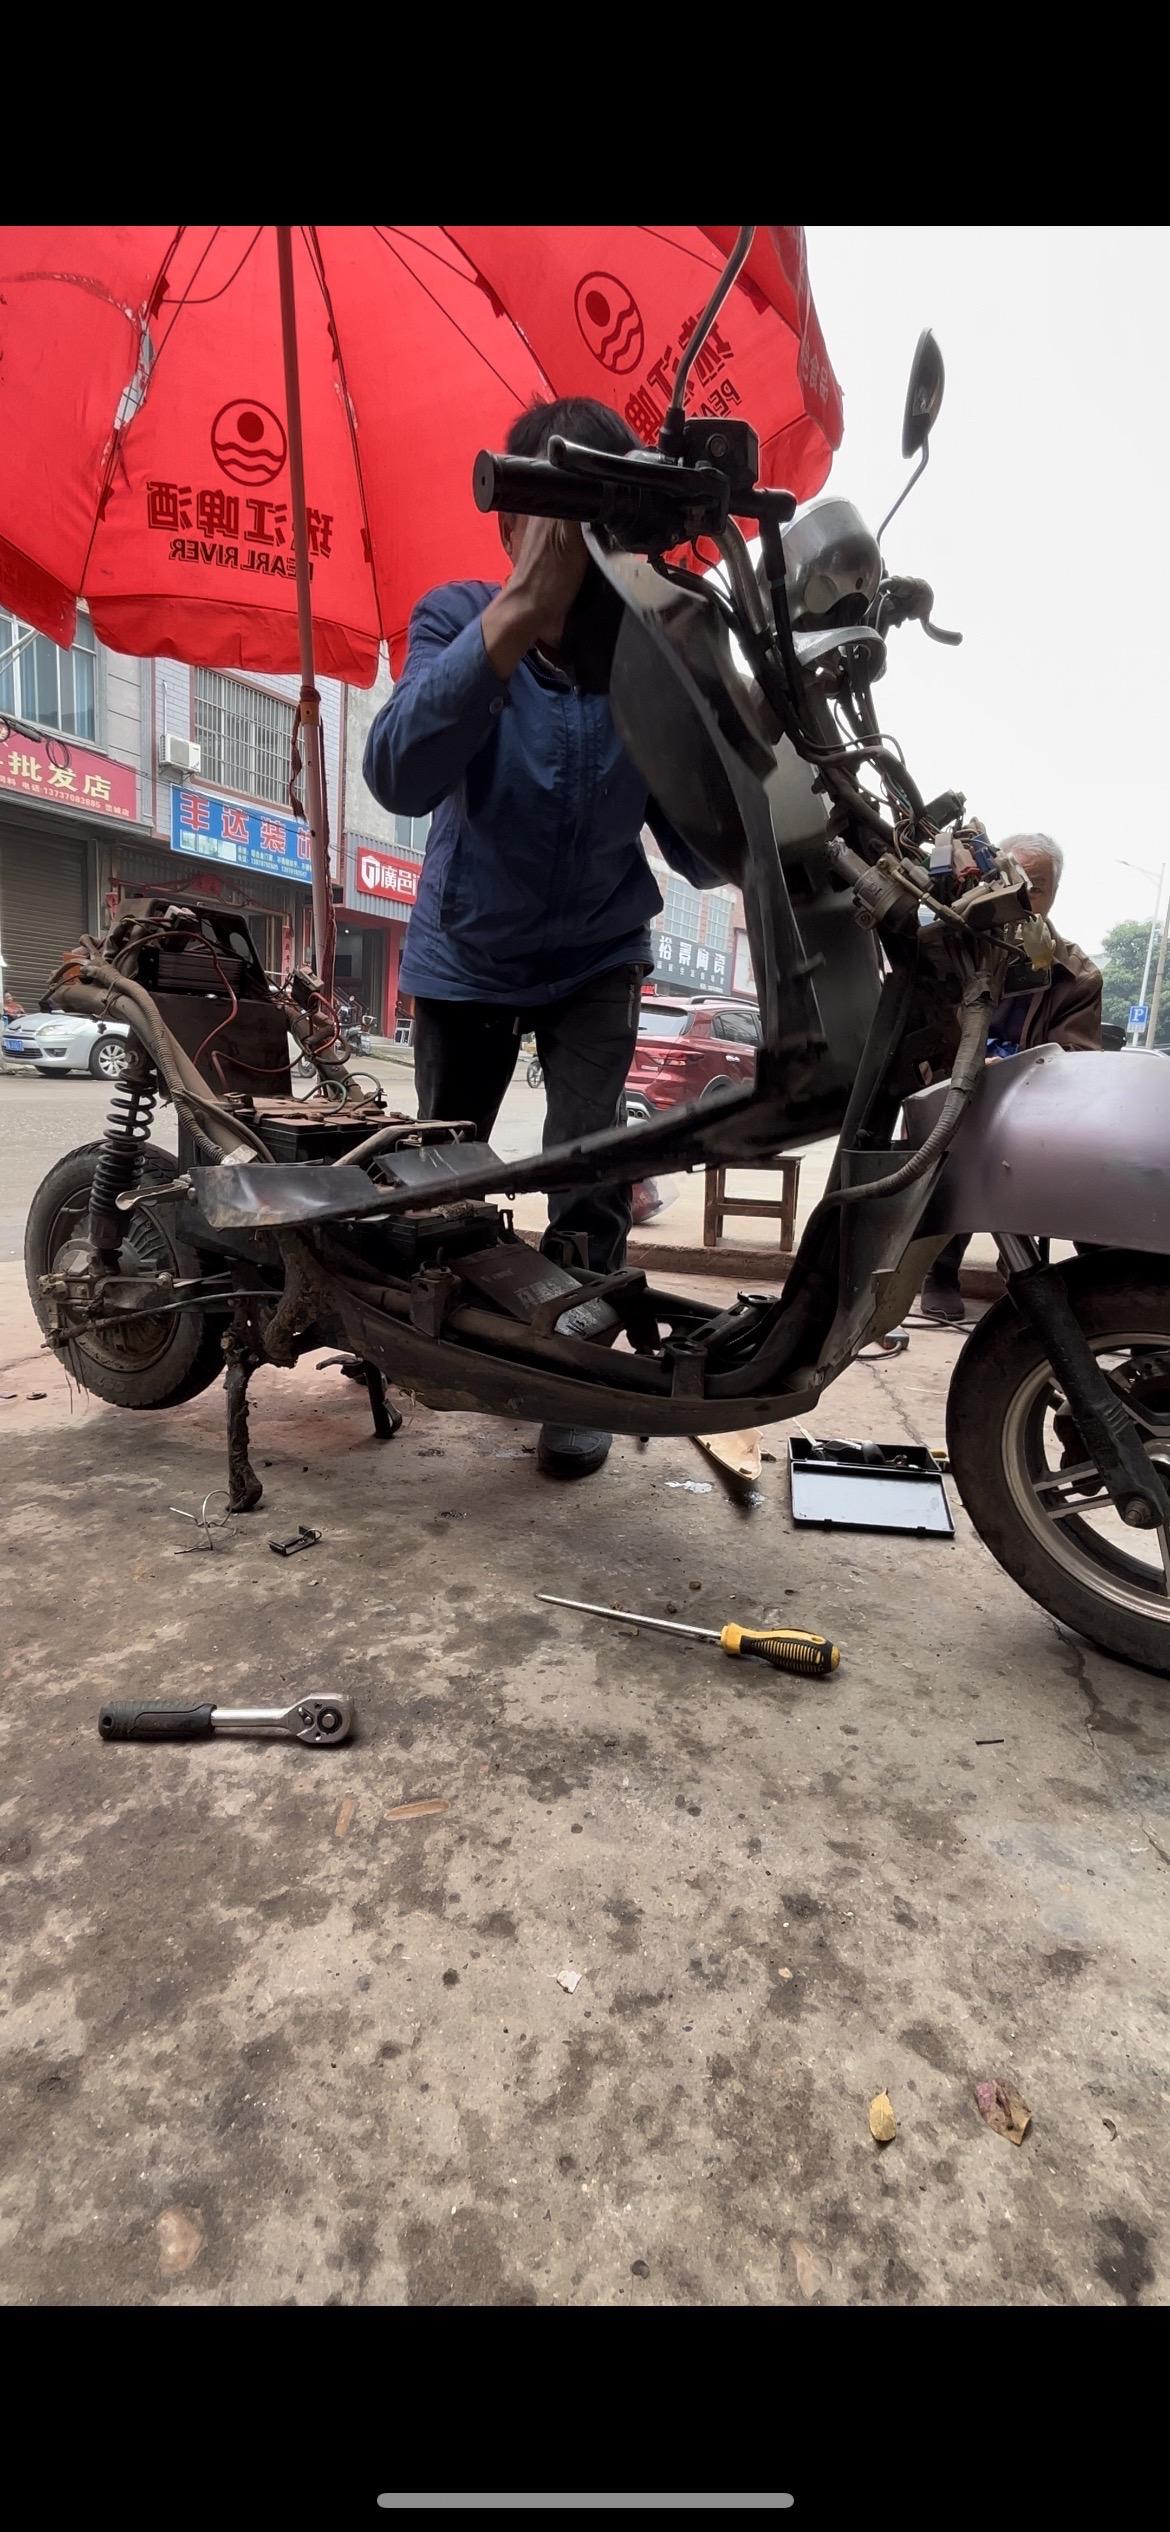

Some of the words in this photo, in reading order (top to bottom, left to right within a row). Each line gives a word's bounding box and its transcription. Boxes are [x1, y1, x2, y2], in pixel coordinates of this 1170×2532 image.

[0, 743, 111, 801] 批发店
[381, 865, 420, 896] 廣邑
[659, 935, 726, 975] 裕景陶瓷
[1132, 1008, 1145, 1021] P
